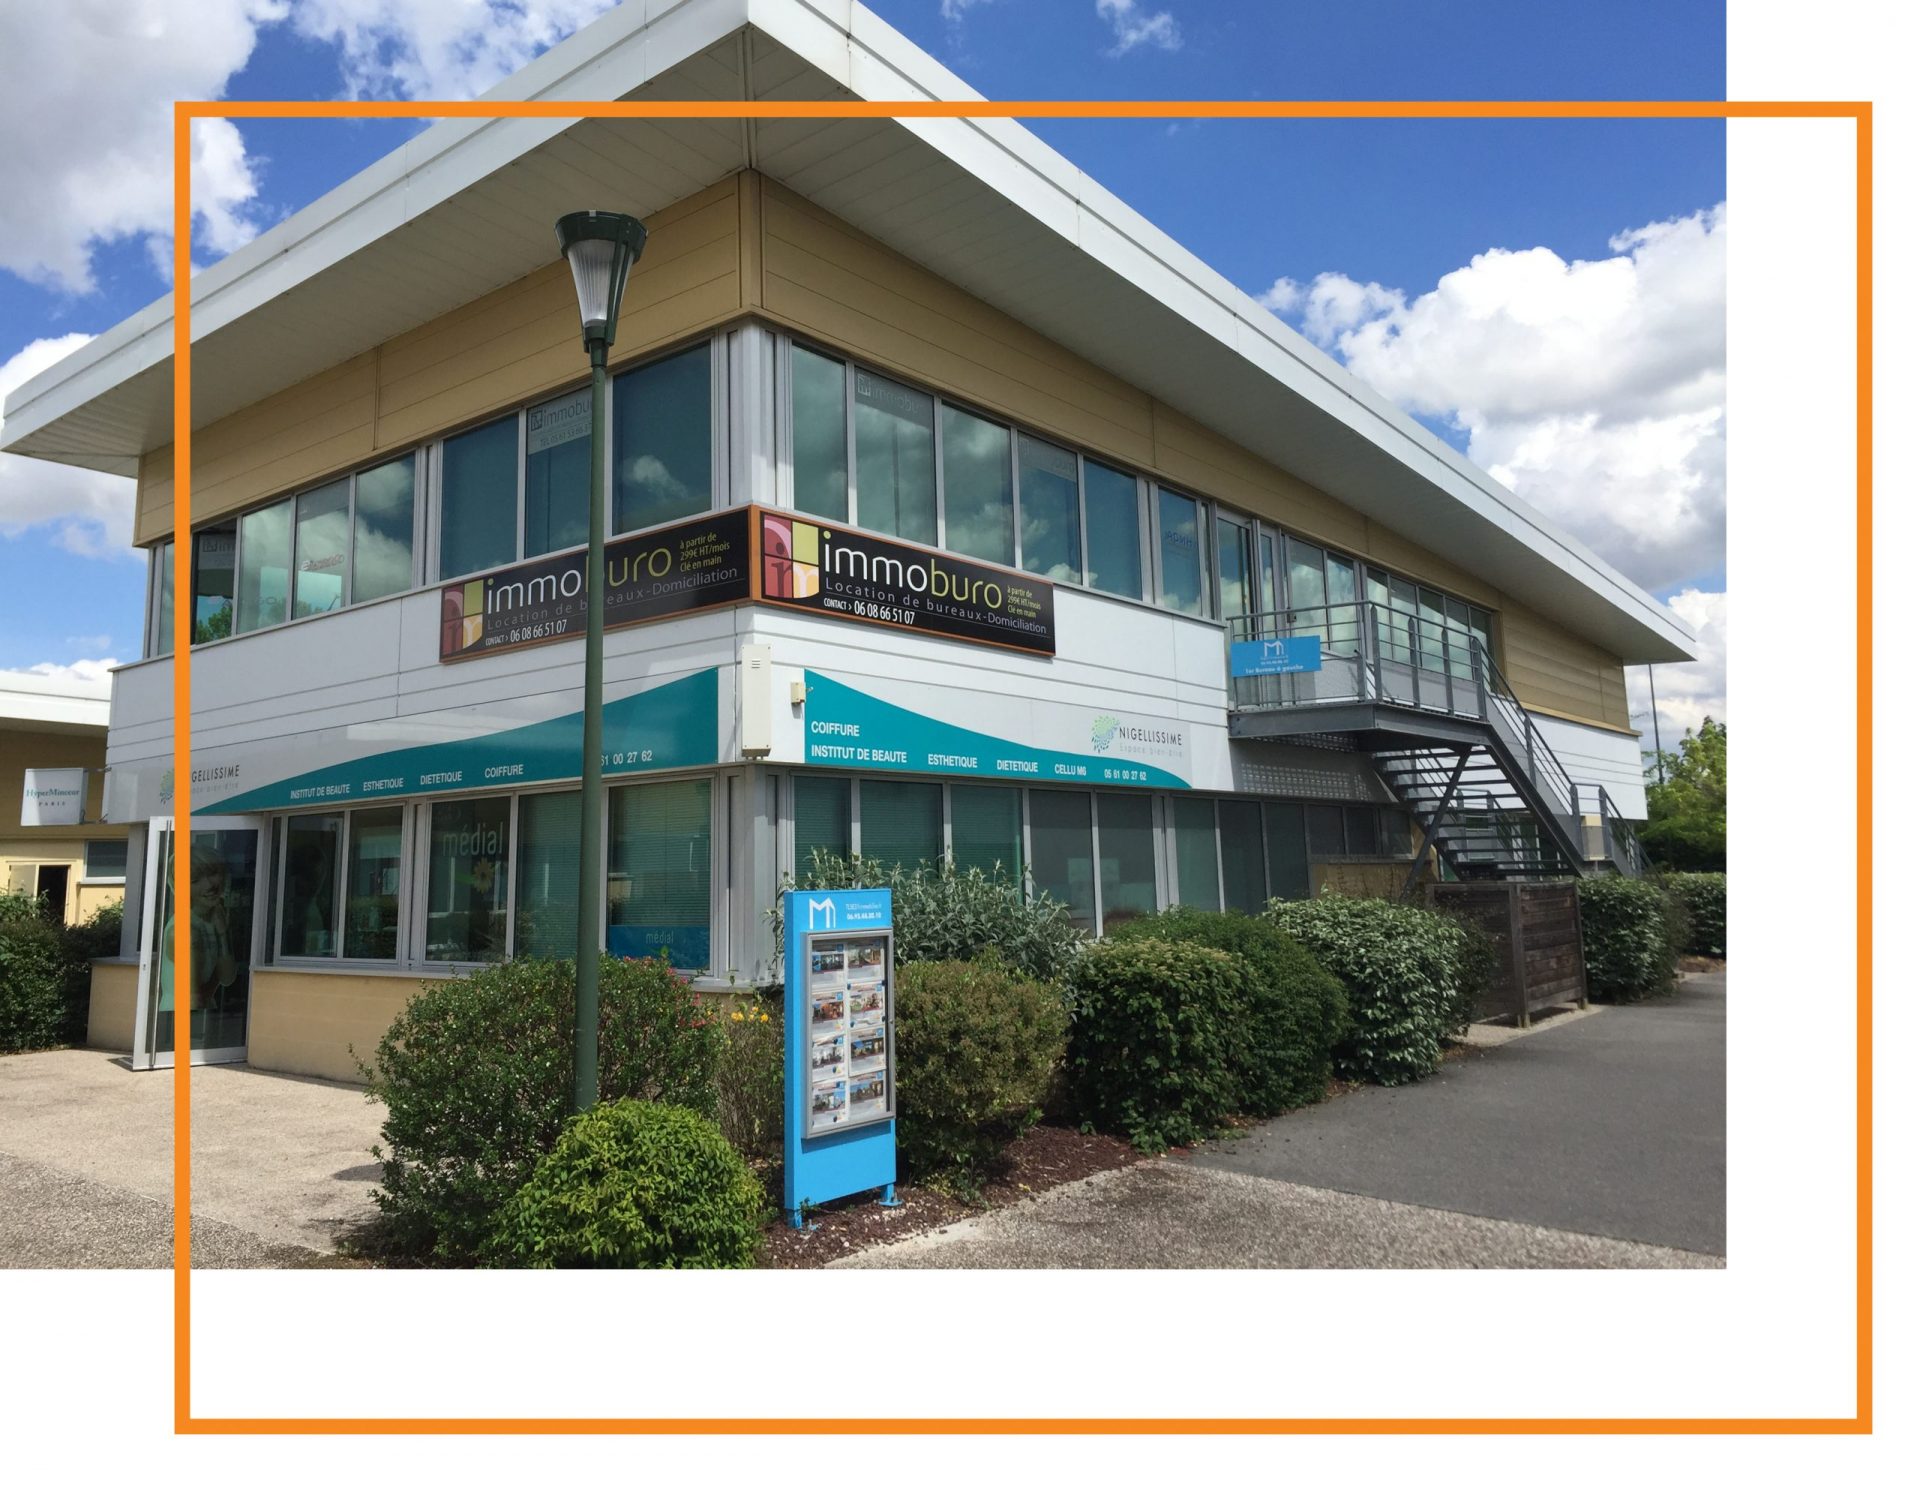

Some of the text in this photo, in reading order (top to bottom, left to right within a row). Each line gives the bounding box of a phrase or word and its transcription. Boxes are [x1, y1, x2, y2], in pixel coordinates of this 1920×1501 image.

[680, 531, 717, 551] à partir de
[680, 542, 731, 561] 299€ HT/mois
[680, 555, 723, 573] Clé en main
[822, 530, 1002, 609] immoburo
[487, 547, 672, 614] immouro
[825, 577, 896, 603] Location
[902, 593, 920, 608] de
[487, 566, 738, 631] Location de beaux-Domiciliation
[823, 597, 915, 625] CONTACT 06 08 66 51 07
[485, 618, 567, 647] CONTACT 06 08 66 51 07
[811, 721, 860, 737] COIFFURE
[1119, 727, 1183, 746] NIGELLISSIME
[191, 764, 240, 783] GELLISSIME
[290, 788, 314, 800] INSTITUT
[316, 787, 325, 797] DE
[326, 783, 350, 796] BEAUTE
[363, 777, 404, 792] ESTHETIQUE
[420, 770, 463, 786] DIETETIQUE
[484, 764, 524, 779] COIFFURE
[613, 753, 624, 765] 00
[627, 751, 638, 764] 27
[641, 750, 653, 762] 62
[811, 744, 1147, 781] INSTITUT DE BEAUTE ESTHETIQUE DIETETIQUE CELLU M6 05 61 00 27 62
[442, 821, 504, 857] médial
[645, 929, 674, 945] médial
